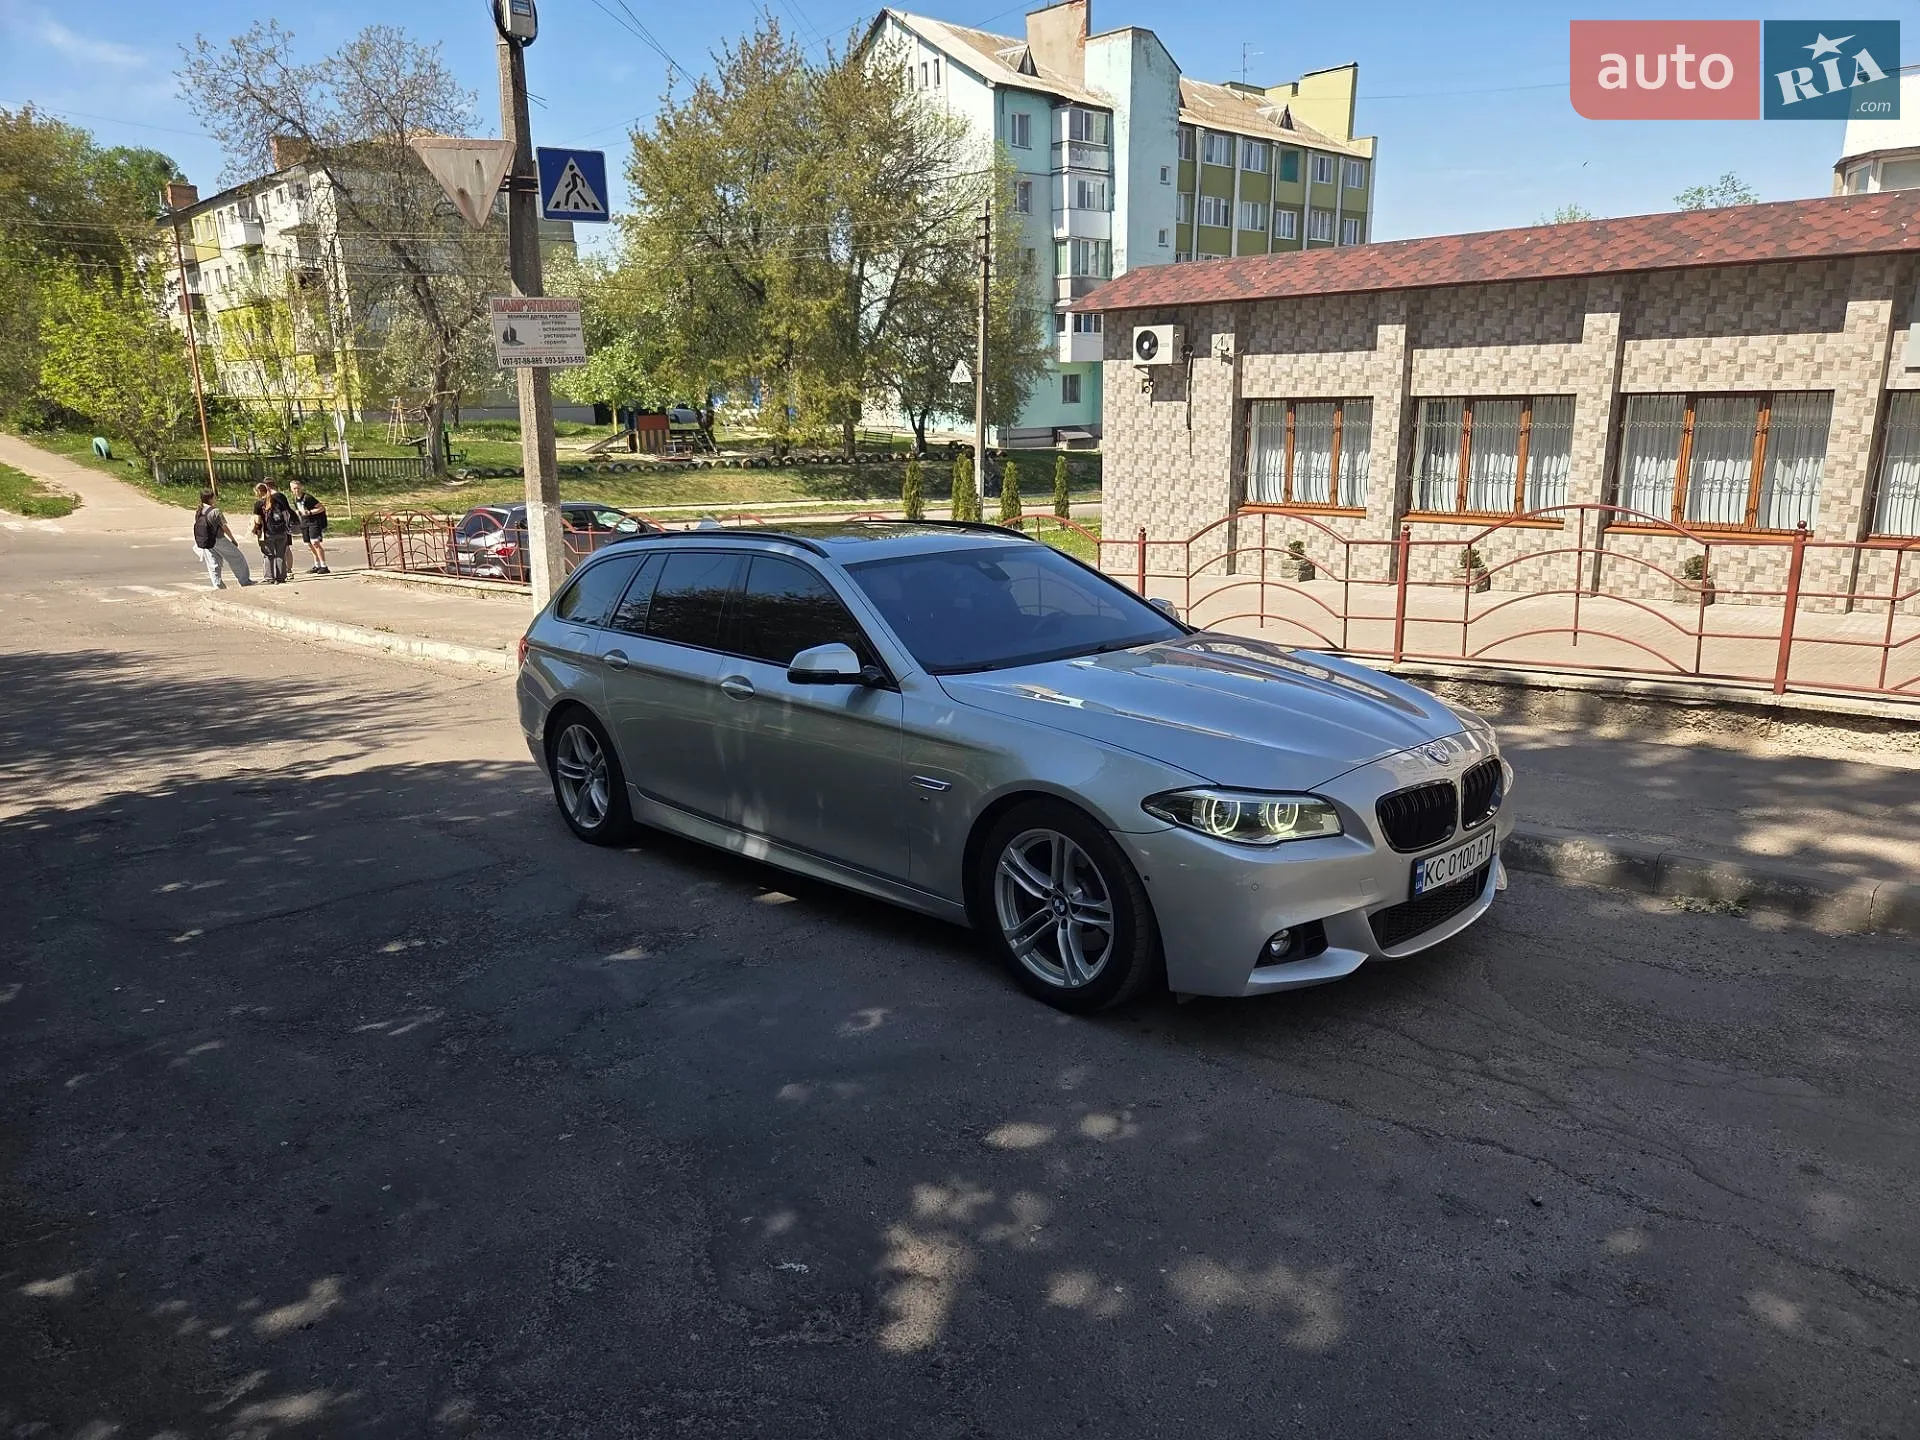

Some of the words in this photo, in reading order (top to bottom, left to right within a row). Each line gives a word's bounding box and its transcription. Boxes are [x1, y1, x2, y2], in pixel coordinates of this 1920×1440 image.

[1425, 858, 1445, 886] KC
[1449, 844, 1475, 876] 0100
[1477, 834, 1491, 862] AT
